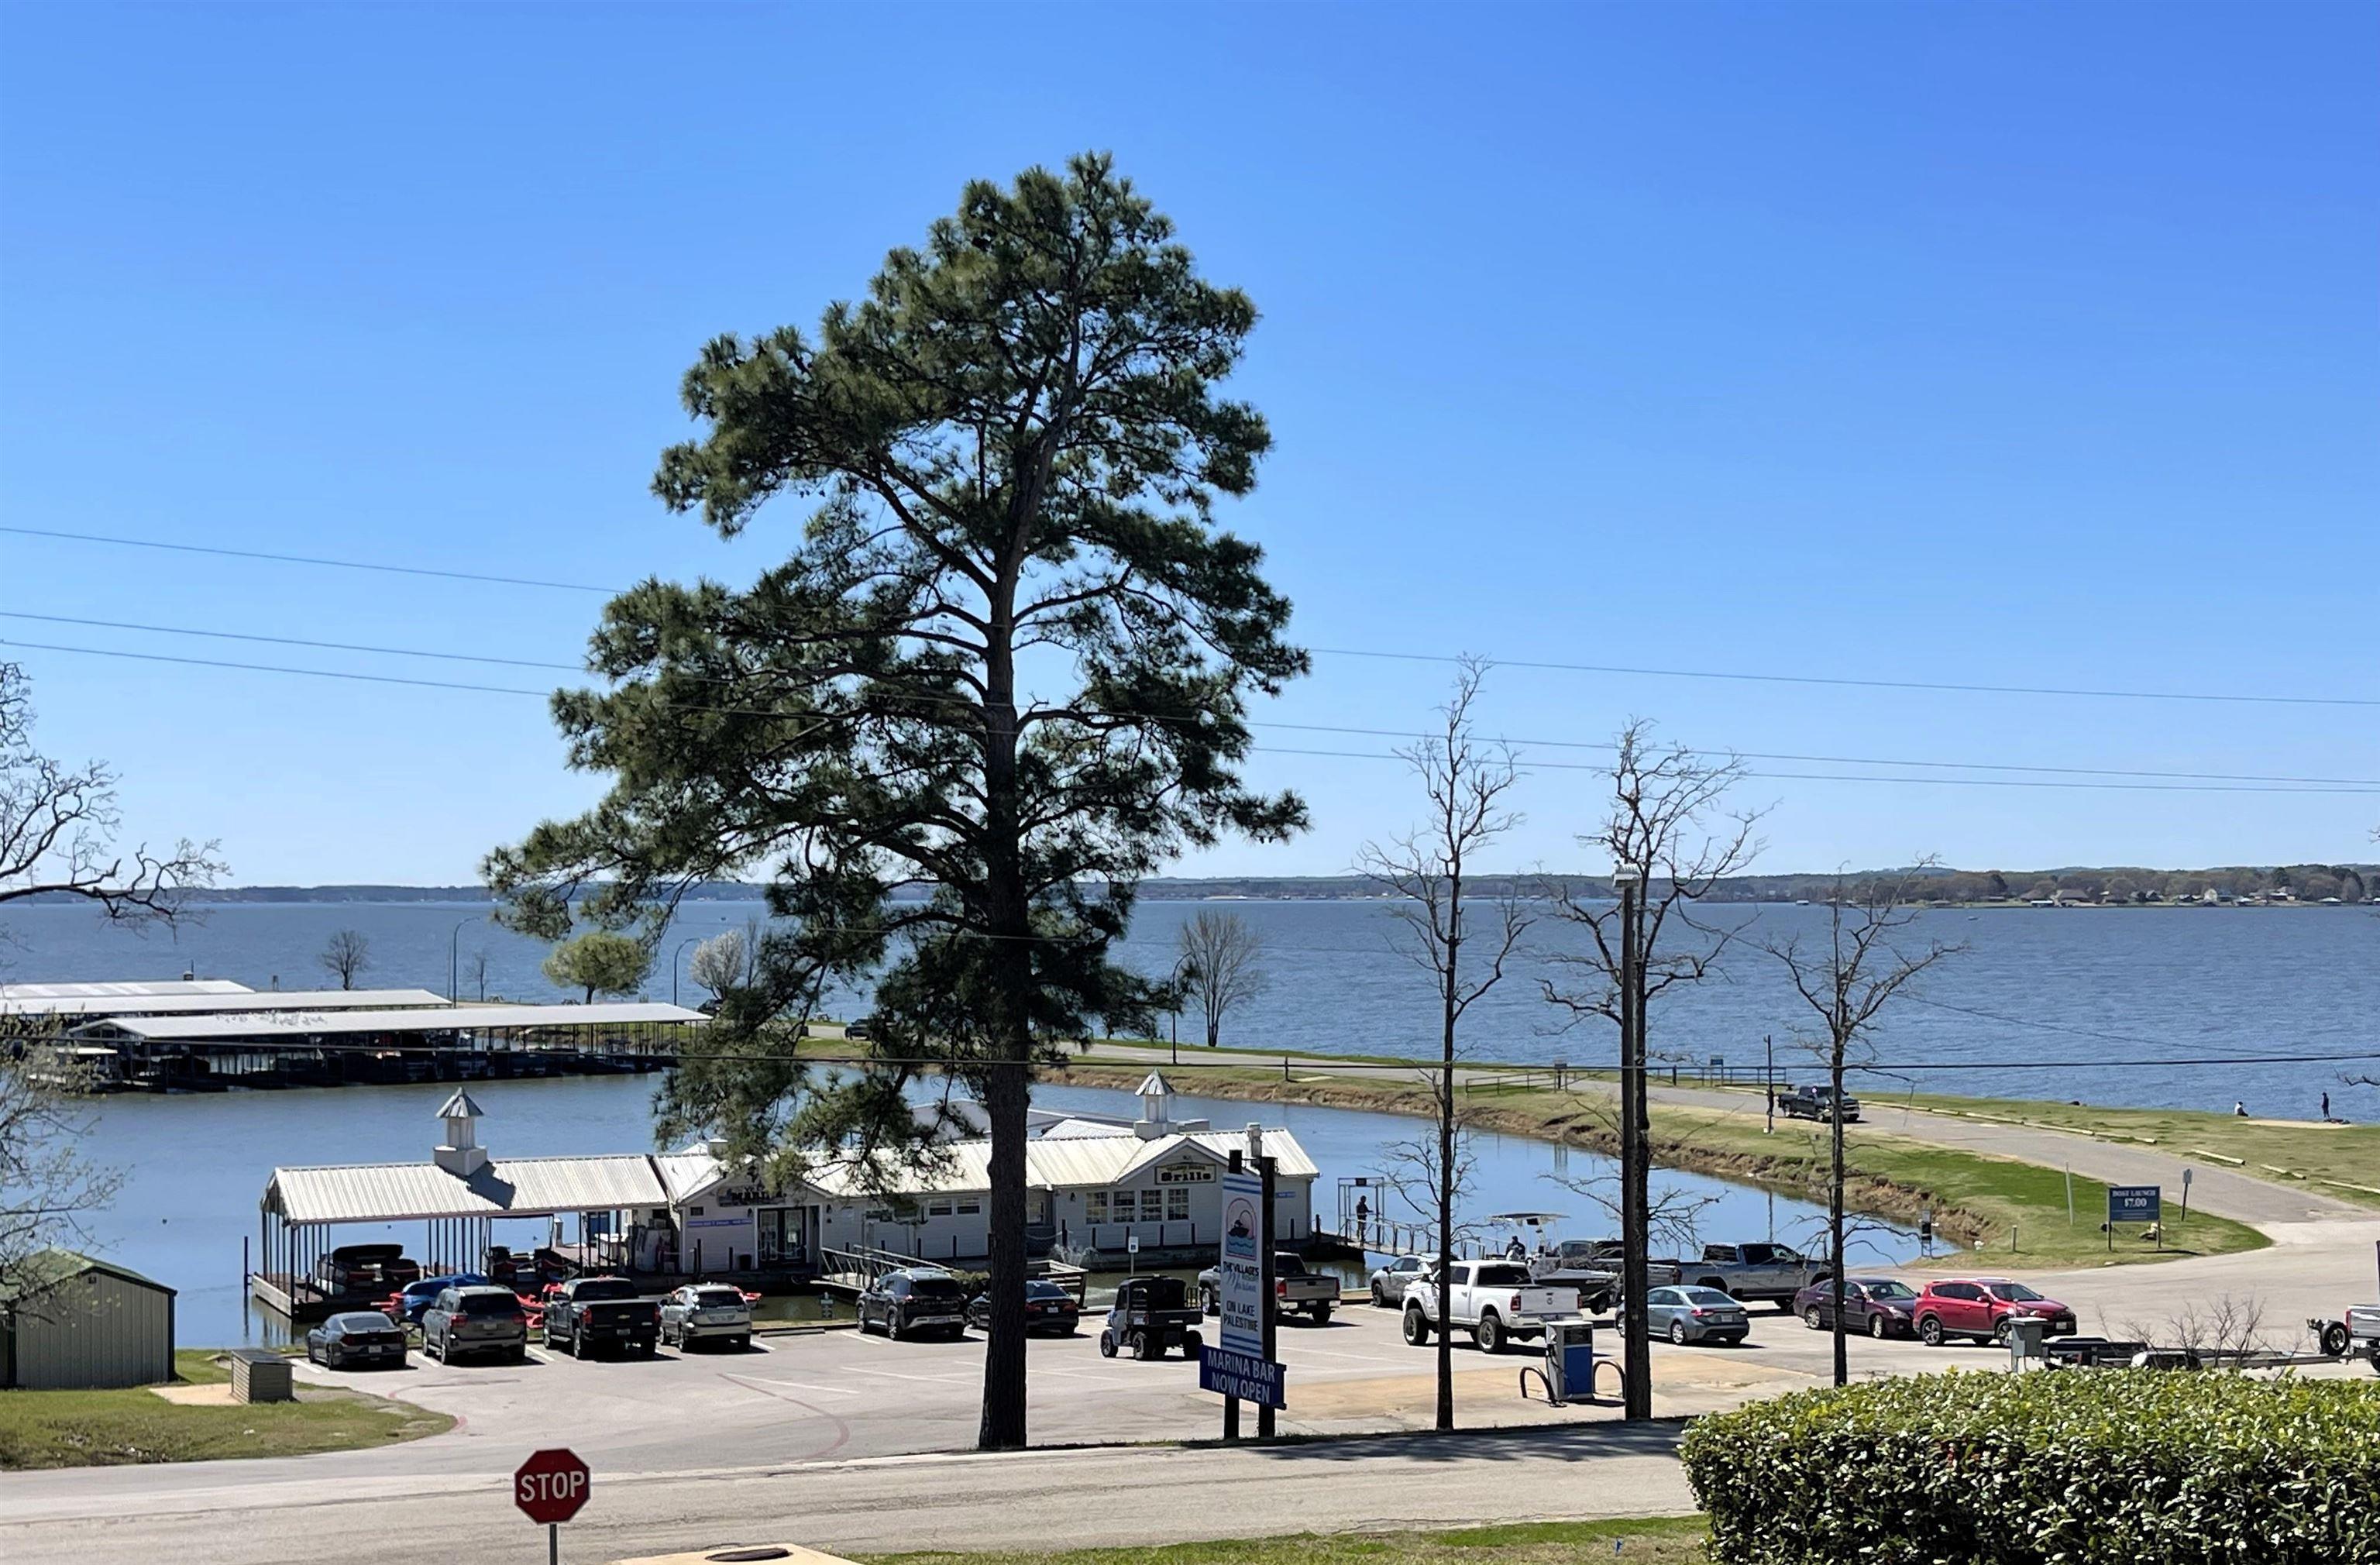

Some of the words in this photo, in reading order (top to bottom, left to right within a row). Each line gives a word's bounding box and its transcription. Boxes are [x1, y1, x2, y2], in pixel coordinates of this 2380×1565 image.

[2124, 1197, 2148, 1208] $7.00
[1226, 1300, 1236, 1312] ON
[1238, 1302, 1255, 1317] LAKE
[1223, 1313, 1259, 1332] PALESTINE
[1208, 1350, 1250, 1377] MARINA
[1252, 1360, 1275, 1383] BAR
[1212, 1371, 1238, 1395] NOW
[1240, 1379, 1270, 1404] OPEN
[520, 1470, 585, 1502] STOP
